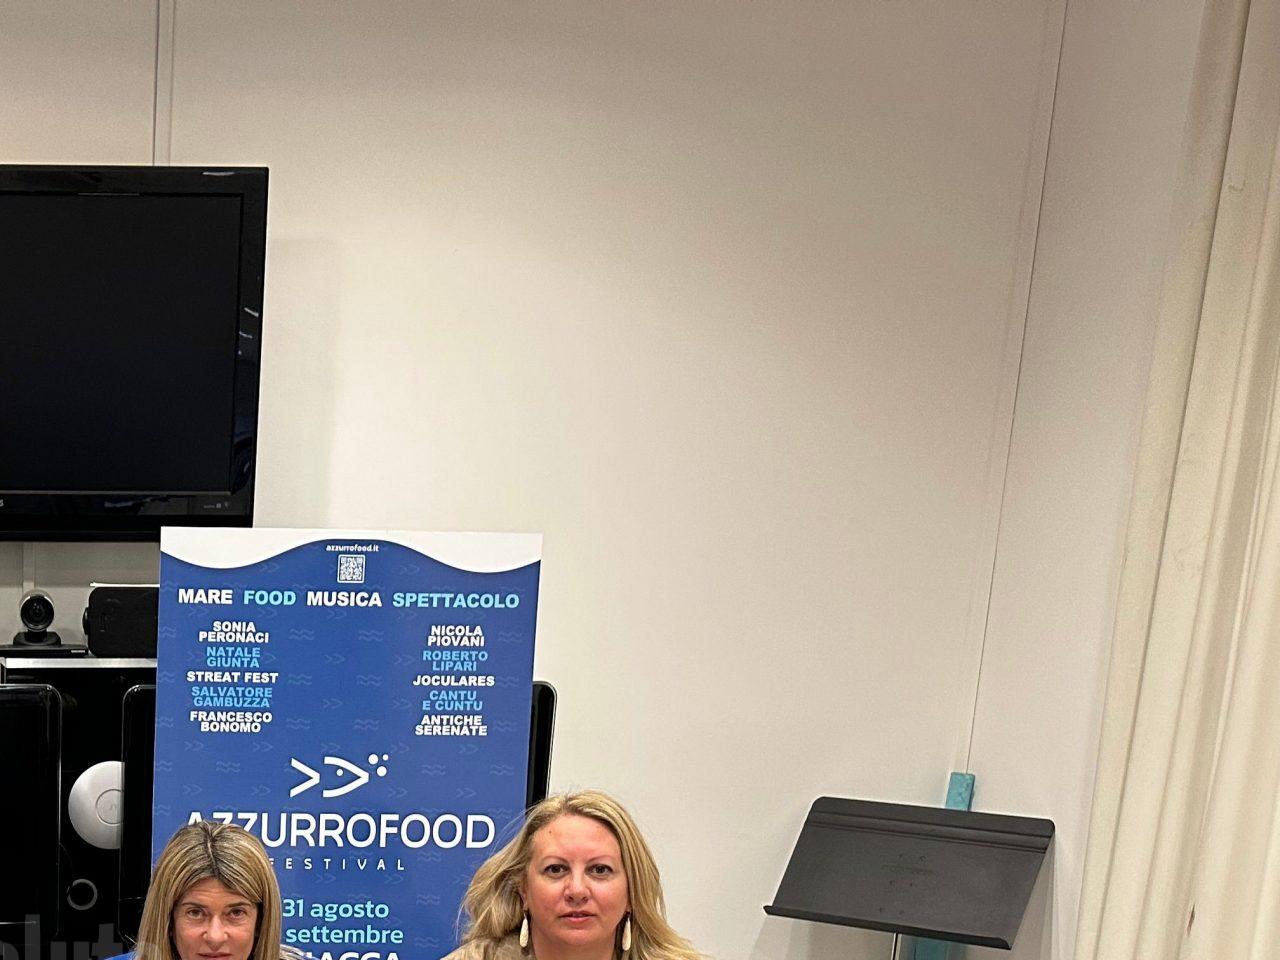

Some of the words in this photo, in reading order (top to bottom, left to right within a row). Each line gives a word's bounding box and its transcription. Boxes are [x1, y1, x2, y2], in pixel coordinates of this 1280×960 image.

[326, 544, 379, 552] azzurrofood.it
[178, 588, 234, 605] MARE
[243, 590, 297, 606] FOOD
[306, 591, 383, 608] MUSICA
[392, 592, 520, 609] SPETTACOLO
[212, 620, 257, 633] SONIA
[430, 625, 483, 637] NICOLA
[198, 631, 270, 643] PERONACI
[427, 635, 485, 647] PIOVANI
[206, 646, 261, 658] NATALE
[422, 650, 488, 662] ROBERTO
[206, 657, 260, 668] GIUNTA
[432, 661, 477, 672] LIPARI
[186, 671, 243, 683] STREAT
[244, 672, 279, 684] FEST
[412, 675, 496, 687] JOCULARES
[191, 686, 273, 698] SALVATORE
[429, 690, 477, 701] CANTU
[193, 697, 270, 708] GAMBUZZA
[422, 700, 431, 711] E
[434, 700, 483, 711] CUNTU
[189, 711, 273, 723] FRANCESCO
[421, 714, 483, 726] ANTICHE
[200, 721, 262, 733] BONOMO
[414, 725, 488, 736] SERENATE
[282, 899, 304, 918] 31
[310, 900, 389, 922] agosto
[286, 925, 404, 944] settembre
